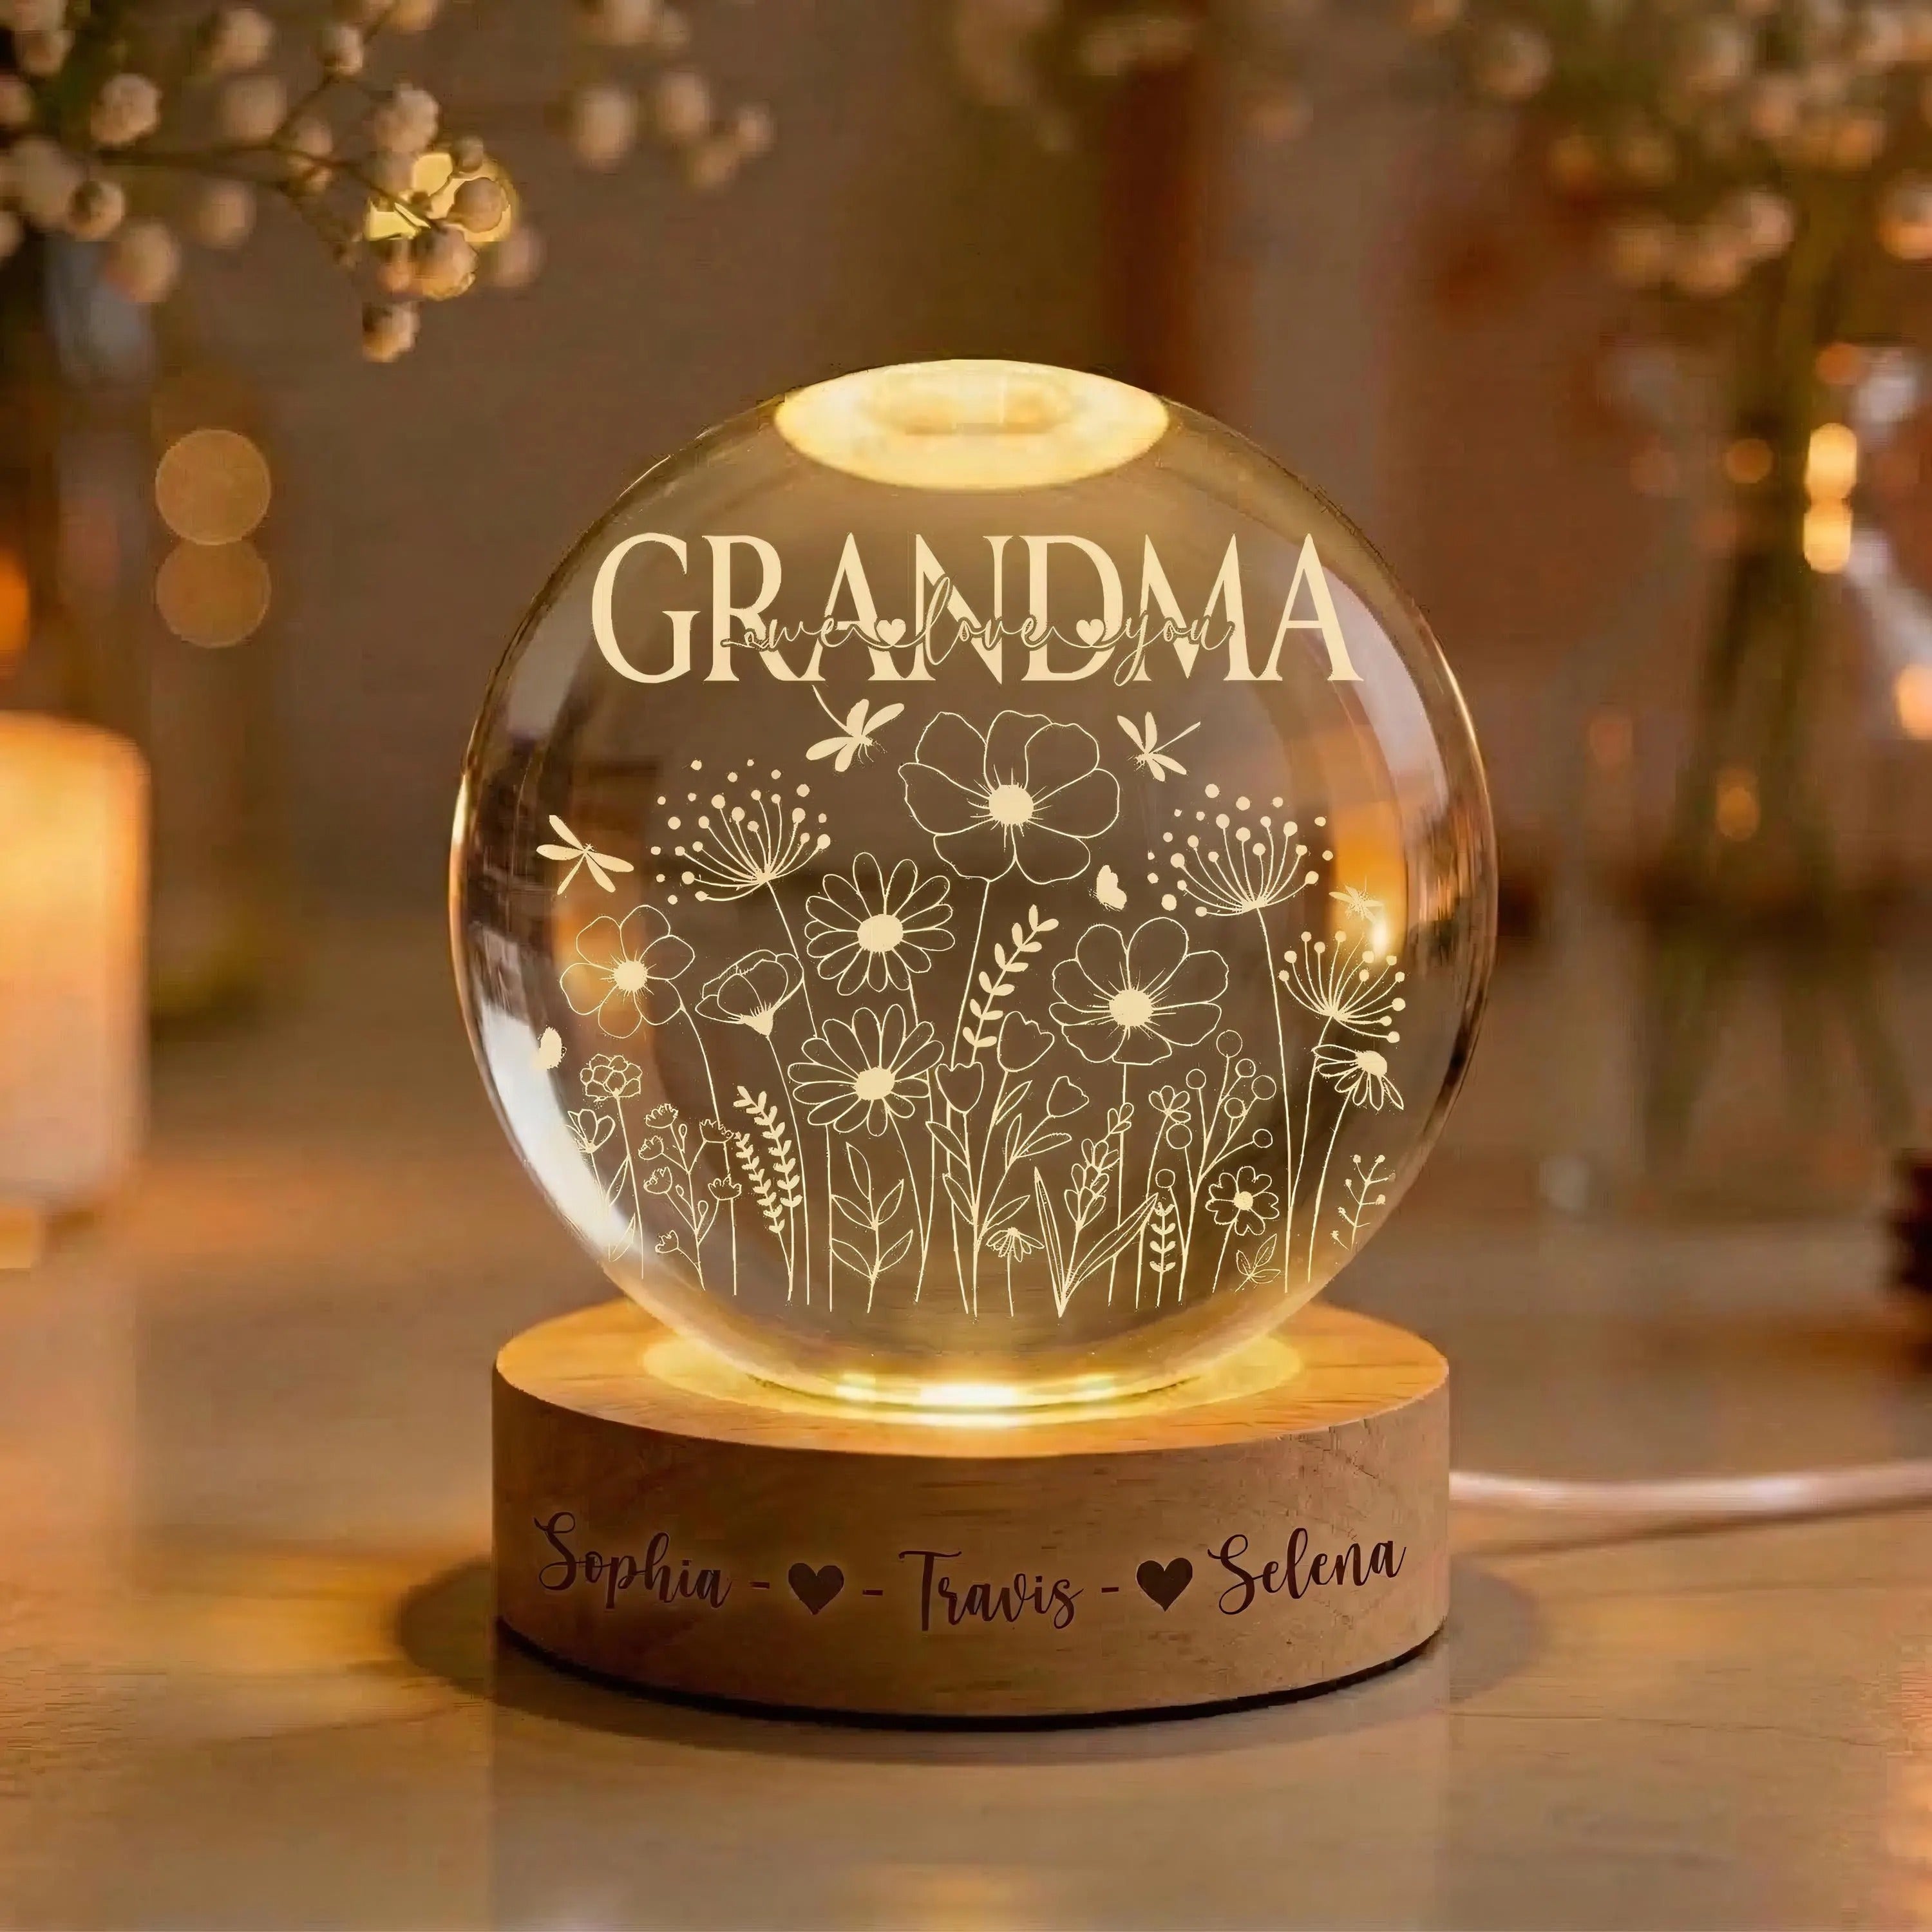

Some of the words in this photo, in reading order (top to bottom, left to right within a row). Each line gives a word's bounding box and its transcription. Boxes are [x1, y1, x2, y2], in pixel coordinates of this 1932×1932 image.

[591, 532, 1364, 685] GRANDMA
[918, 576, 1055, 666] love
[1113, 614, 1234, 687] you
[533, 1511, 733, 1609] Sophia
[898, 1549, 1084, 1632] Travis
[1207, 1527, 1407, 1616] Selena
